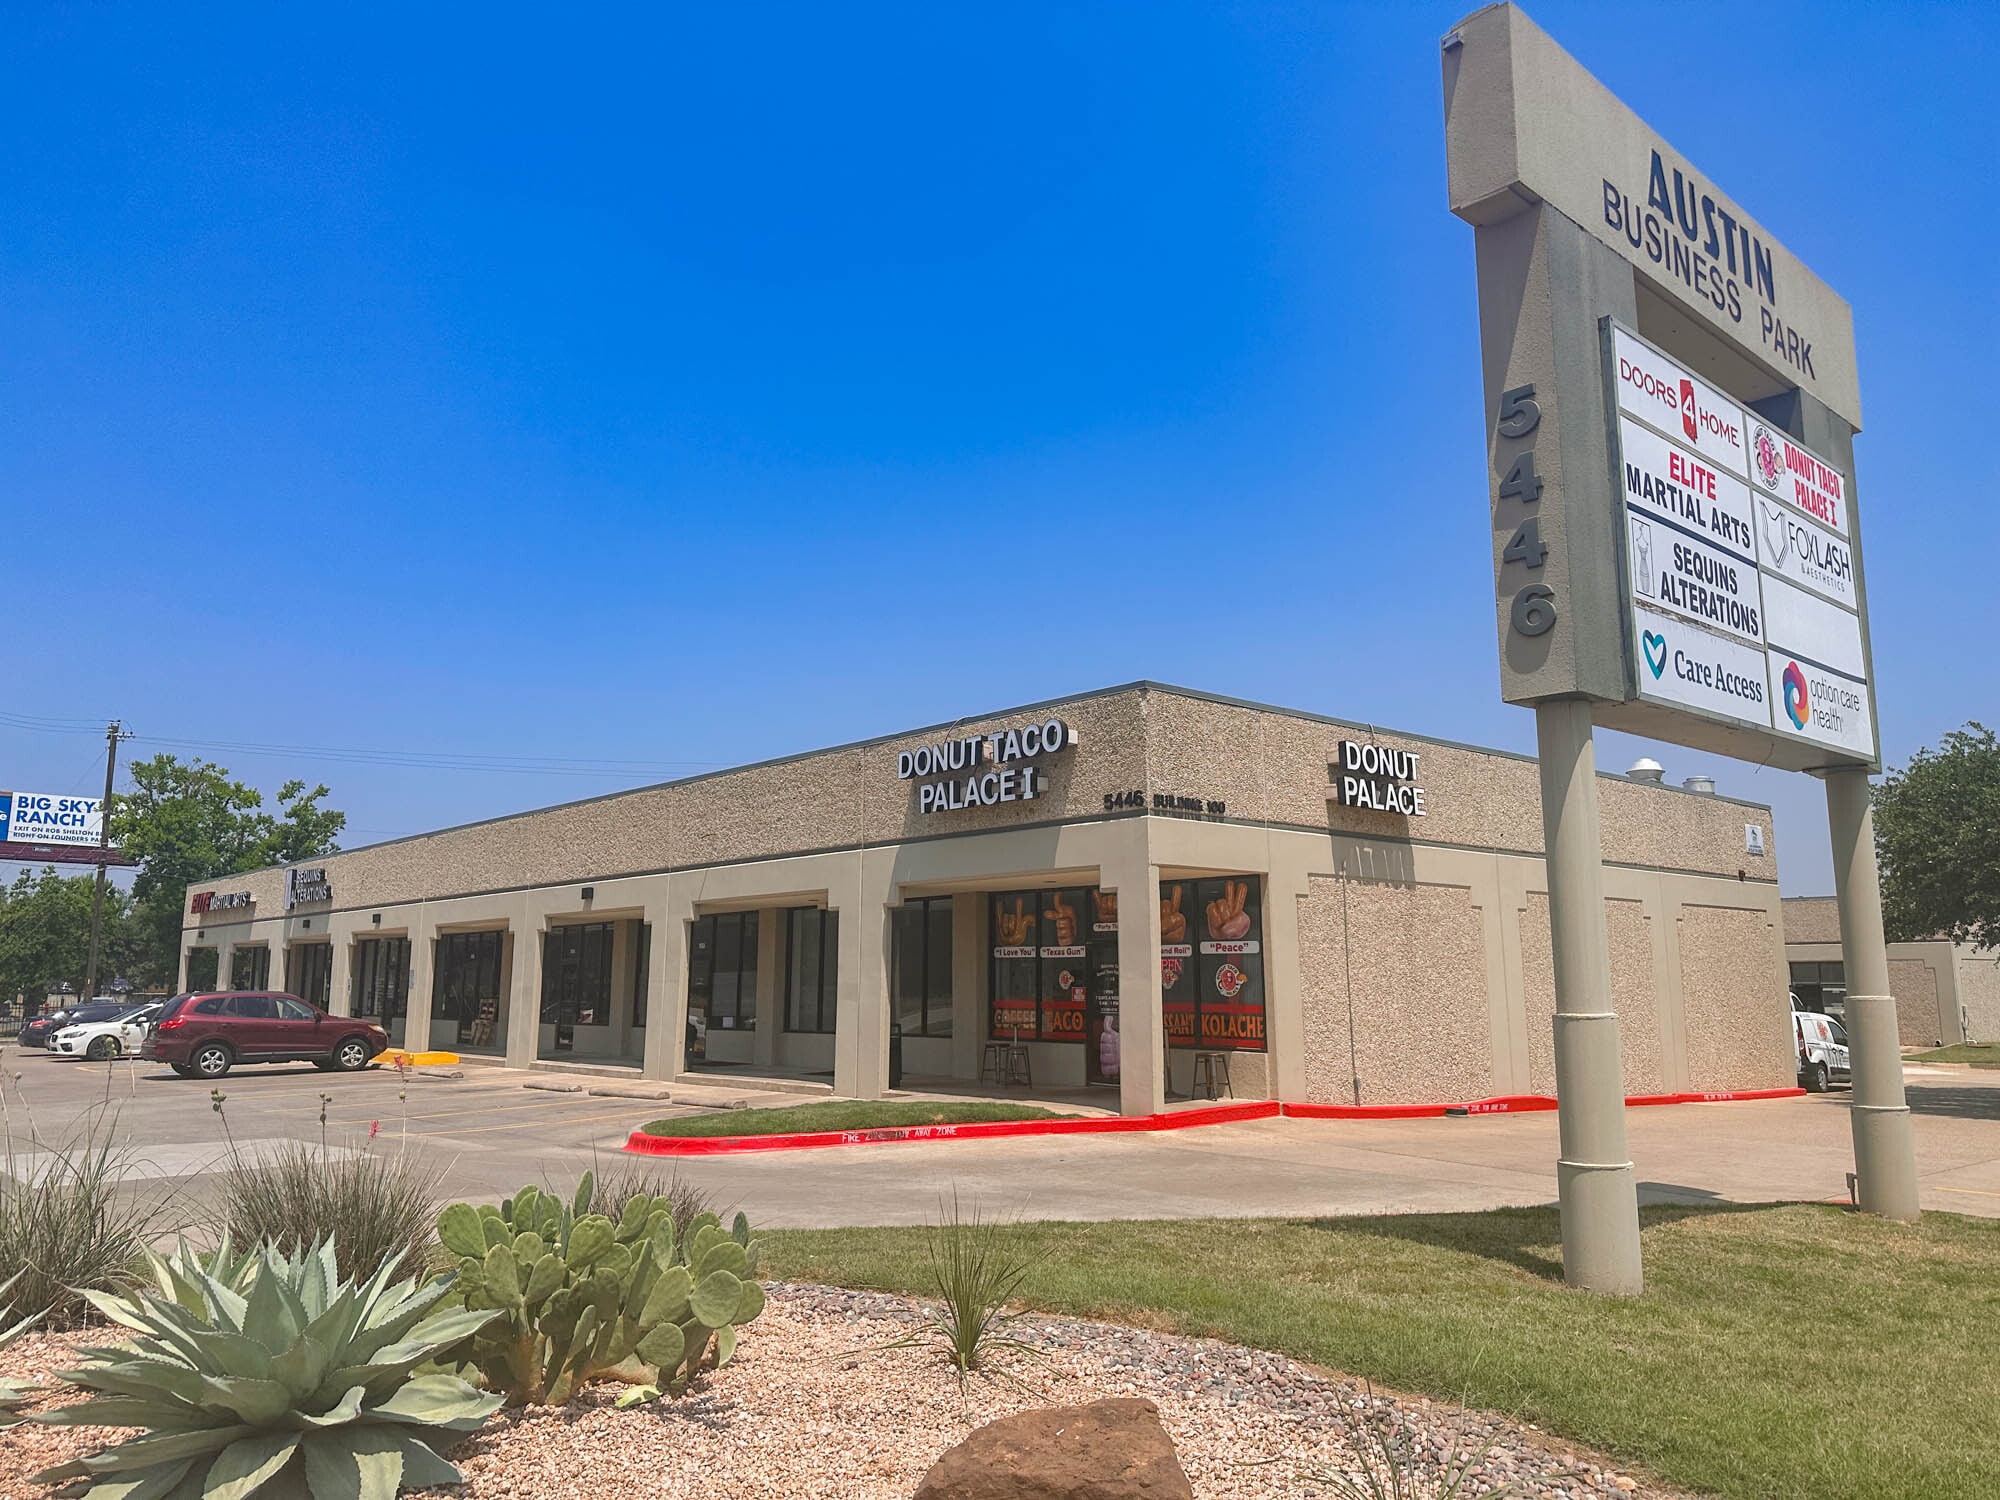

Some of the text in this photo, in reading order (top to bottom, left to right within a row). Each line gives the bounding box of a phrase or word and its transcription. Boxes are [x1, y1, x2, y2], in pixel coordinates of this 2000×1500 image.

[1648, 148, 1775, 306] AUSTIN
[1602, 178, 1816, 380] BUSINESS PARK
[1620, 358, 1740, 448] DOORS 4 HOME
[1669, 451, 1717, 501] ELITE
[1784, 442, 1840, 500] DONUT TACO
[1499, 383, 1557, 637] 5446
[1626, 462, 1750, 549] MARTIAL ARTS
[1794, 478, 1829, 522] PALACE
[1673, 542, 1738, 595] SEQUINS
[1660, 571, 1759, 636] ALTERATIONS
[1674, 650, 1762, 703] Care Access
[1810, 676, 1860, 712] option care
[1811, 702, 1842, 732] health
[897, 718, 1066, 780] DONUT TACO
[1345, 741, 1420, 780] DONUT
[17, 796, 96, 813] BIG SKY
[920, 766, 1034, 814] PALACE I
[1103, 789, 1145, 810] 5446
[1343, 776, 1427, 816] PALACE
[15, 810, 86, 827] RANCH
[232, 890, 248, 909] ARTS
[1161, 959, 1183, 971] PEN
[1045, 1008, 1084, 1031] TACO
[1163, 1013, 1264, 1038] SSANT KOLACHE
[841, 1132, 861, 1144] FIRE
[914, 1128, 932, 1137] AWAY
[936, 1127, 957, 1136] ZONE
